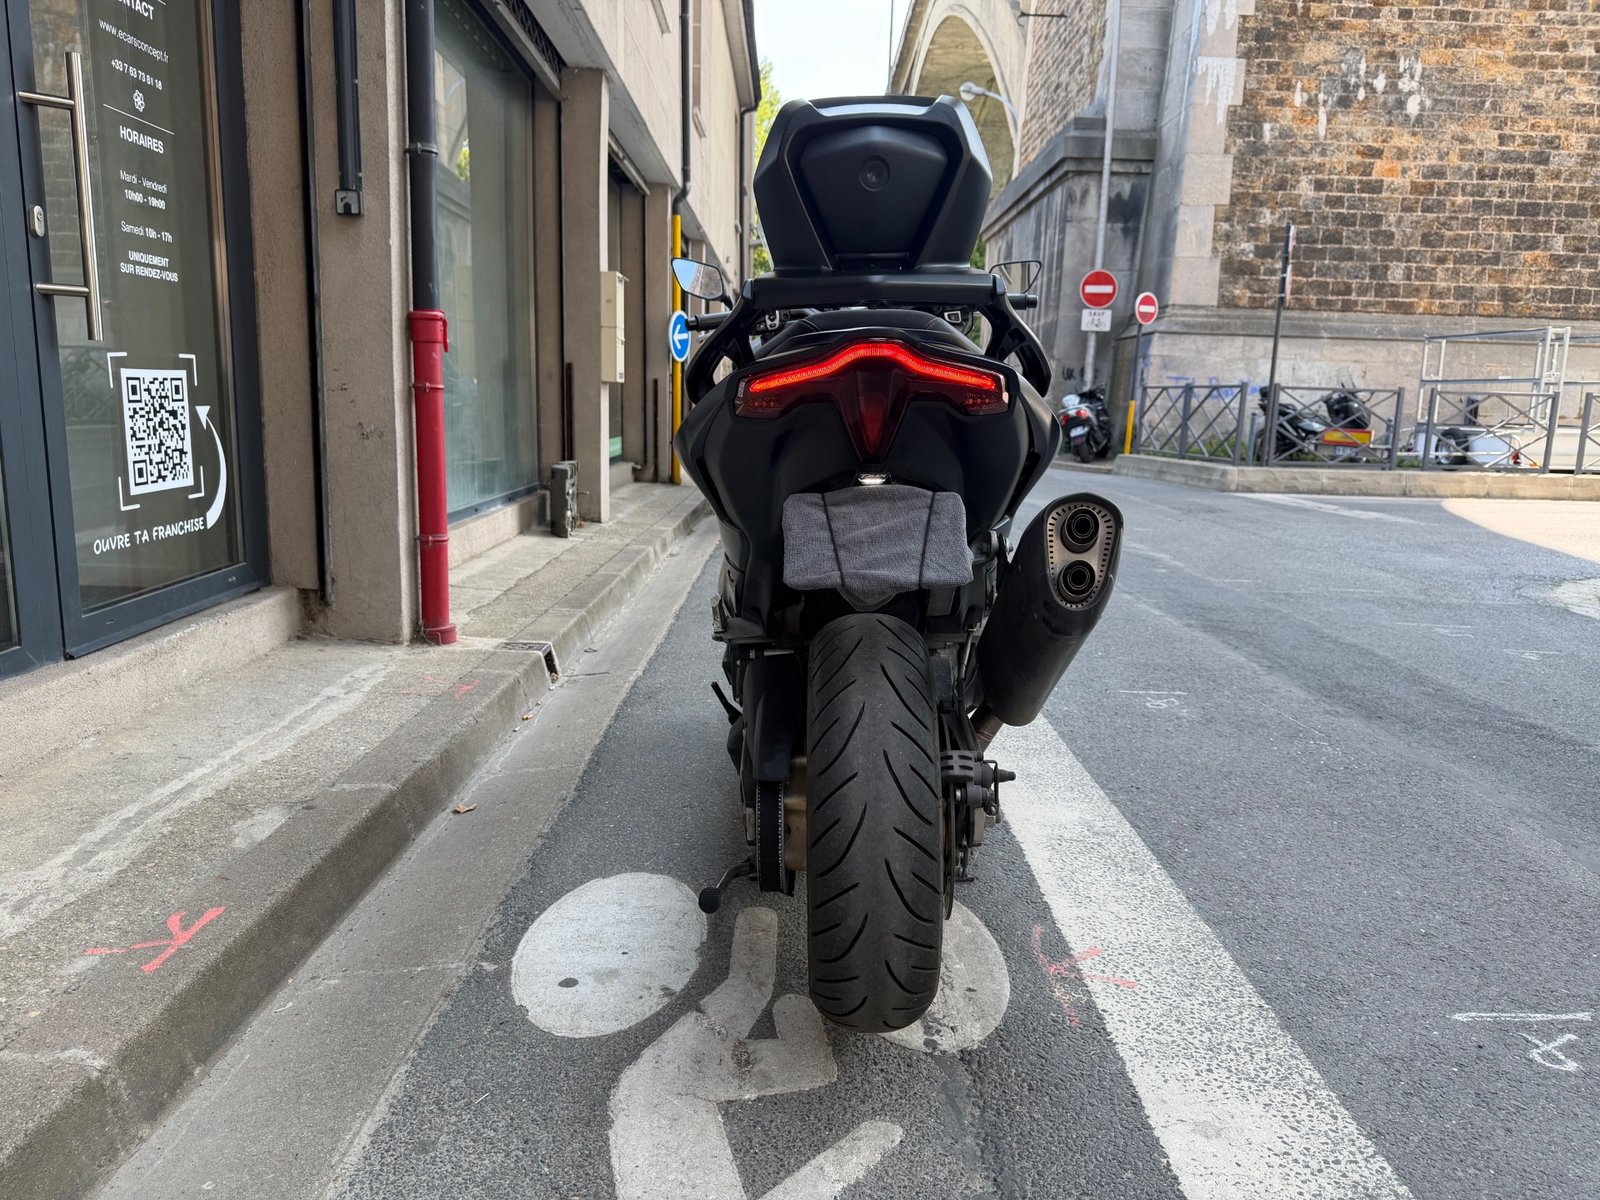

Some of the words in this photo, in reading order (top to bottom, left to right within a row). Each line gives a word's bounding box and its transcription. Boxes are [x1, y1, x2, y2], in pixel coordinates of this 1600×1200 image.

[98, 18, 169, 63] www.ecarsconcept.fr
[111, 59, 123, 72] +33
[123, 63, 128, 73] 7
[129, 66, 137, 79] 63
[138, 70, 146, 82] 73
[146, 74, 153, 86] 81
[155, 79, 162, 91] 18
[119, 125, 164, 154] HORAIRES
[120, 169, 138, 185] Mardi
[141, 176, 168, 194] Vendredi
[124, 188, 144, 203] 10h00
[148, 195, 166, 210] 19h00
[120, 220, 144, 235] Samedi
[145, 227, 157, 239] 10h
[161, 231, 173, 243] 17h
[128, 250, 169, 268] UNIQUEMENT
[120, 261, 134, 275] SUR
[135, 265, 179, 283] RENDEZ-VOUS
[93, 533, 131, 555] OUVRE
[134, 529, 150, 545] TA
[152, 517, 204, 541] FRANCHISE
